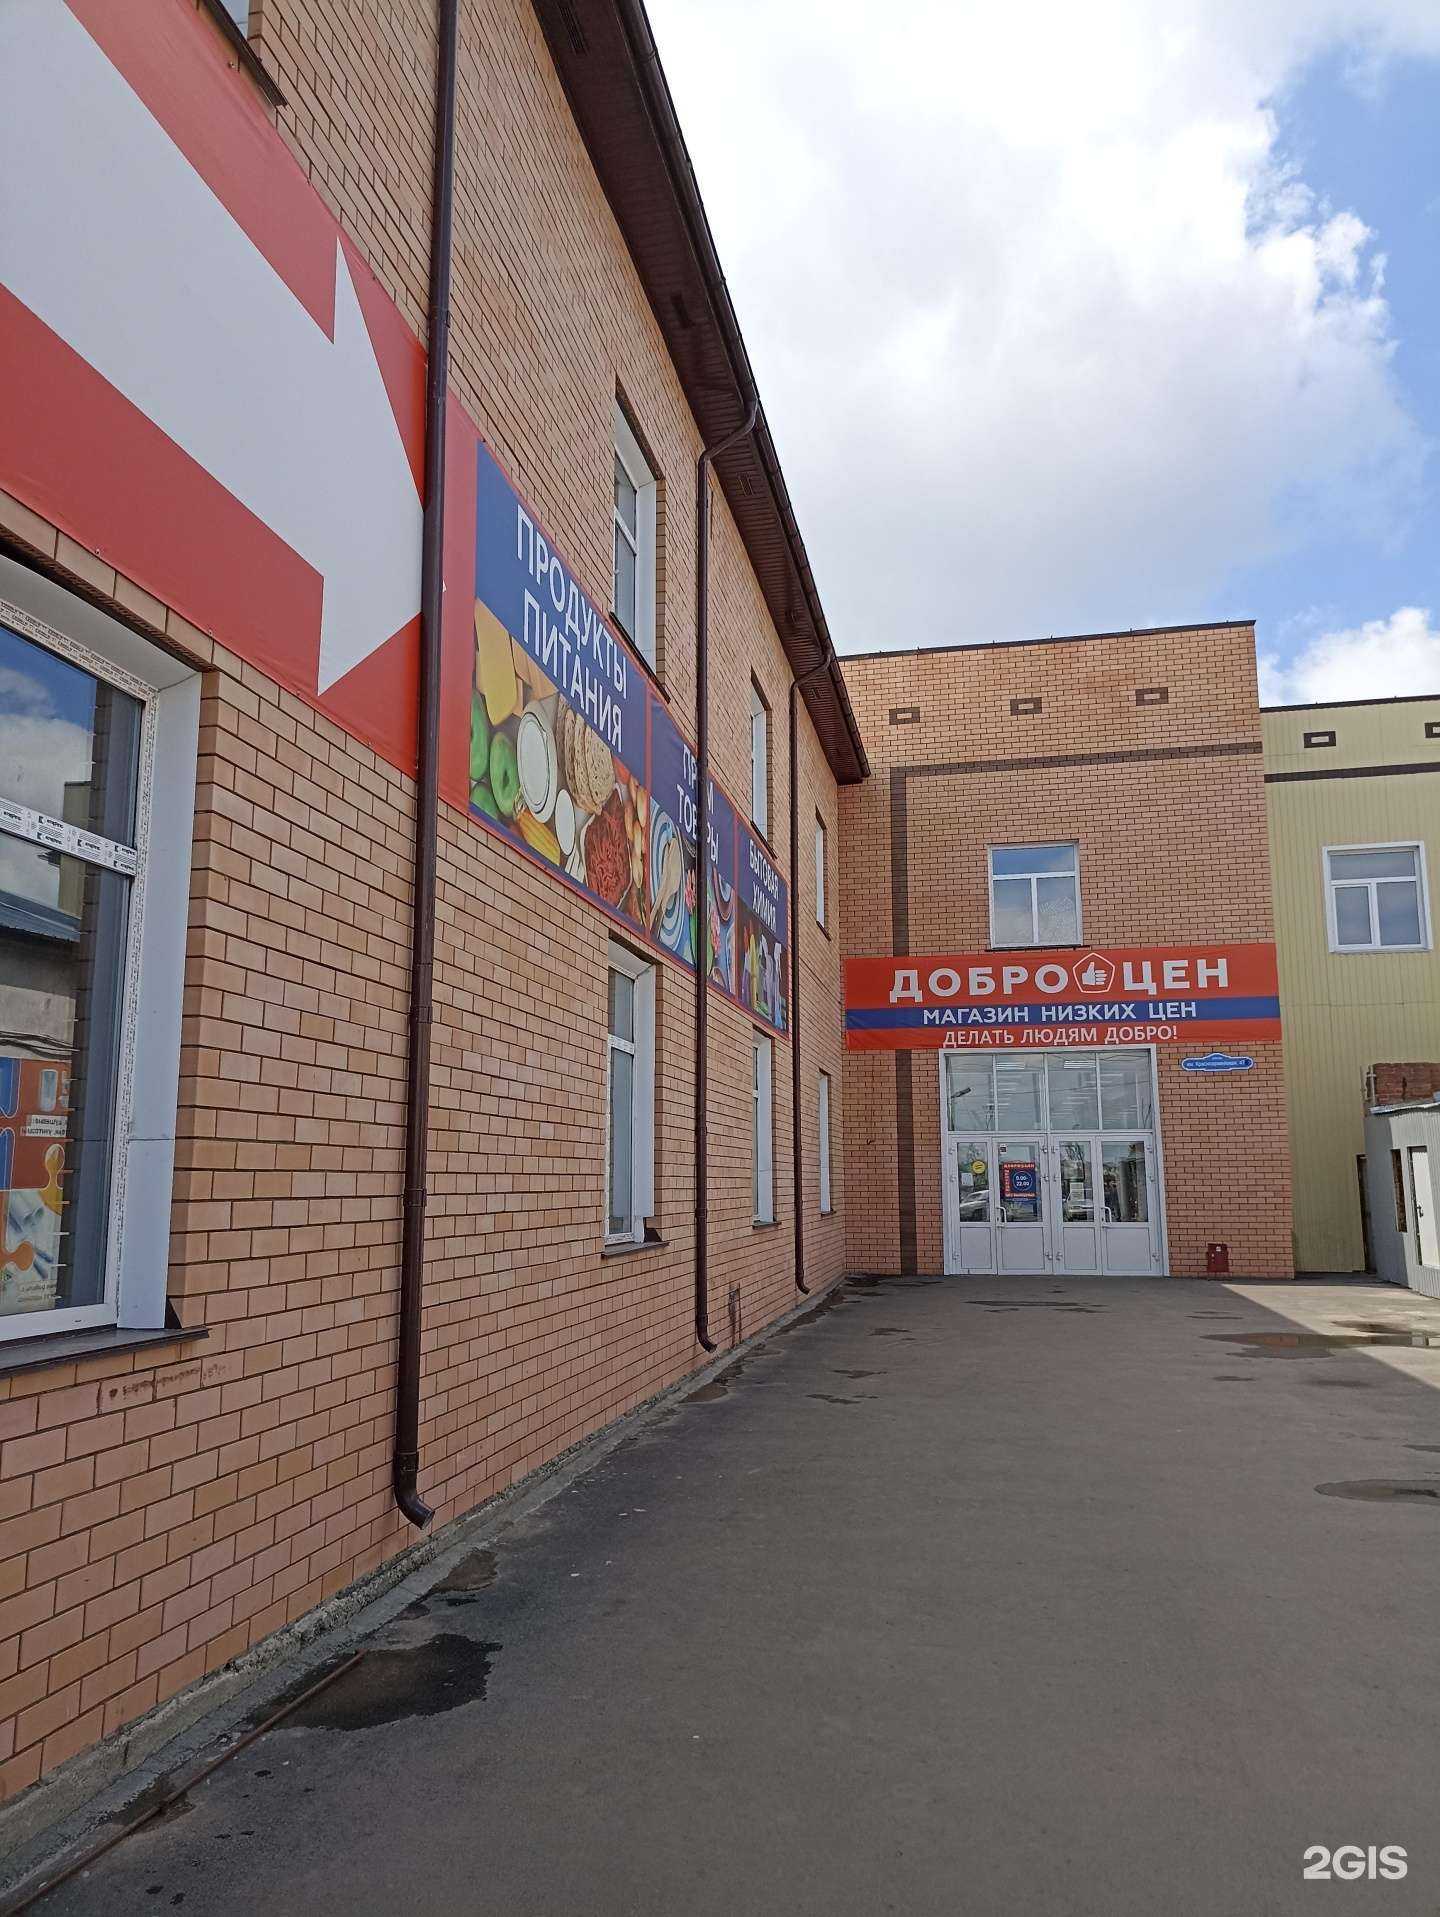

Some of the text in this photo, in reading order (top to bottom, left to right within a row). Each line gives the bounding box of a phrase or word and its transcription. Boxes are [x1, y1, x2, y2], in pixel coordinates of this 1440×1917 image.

[517, 504, 627, 700] ПРОДУКТЫ
[523, 587, 622, 753] ПИТАНИЯ
[683, 743, 715, 815] ПРМ
[676, 783, 719, 865] ТОВЫ
[749, 838, 779, 902] БЫТОВАЯ
[752, 880, 777, 934] ХИМИЯ
[889, 957, 1229, 1004] ДОБРО ЦЕН
[922, 1001, 1197, 1025] МАГАЗИН НИЗКИХ ЦЕН
[942, 1024, 1178, 1049] ДЕЛАТЬ ЛЮДЯМ ДОБРО!
